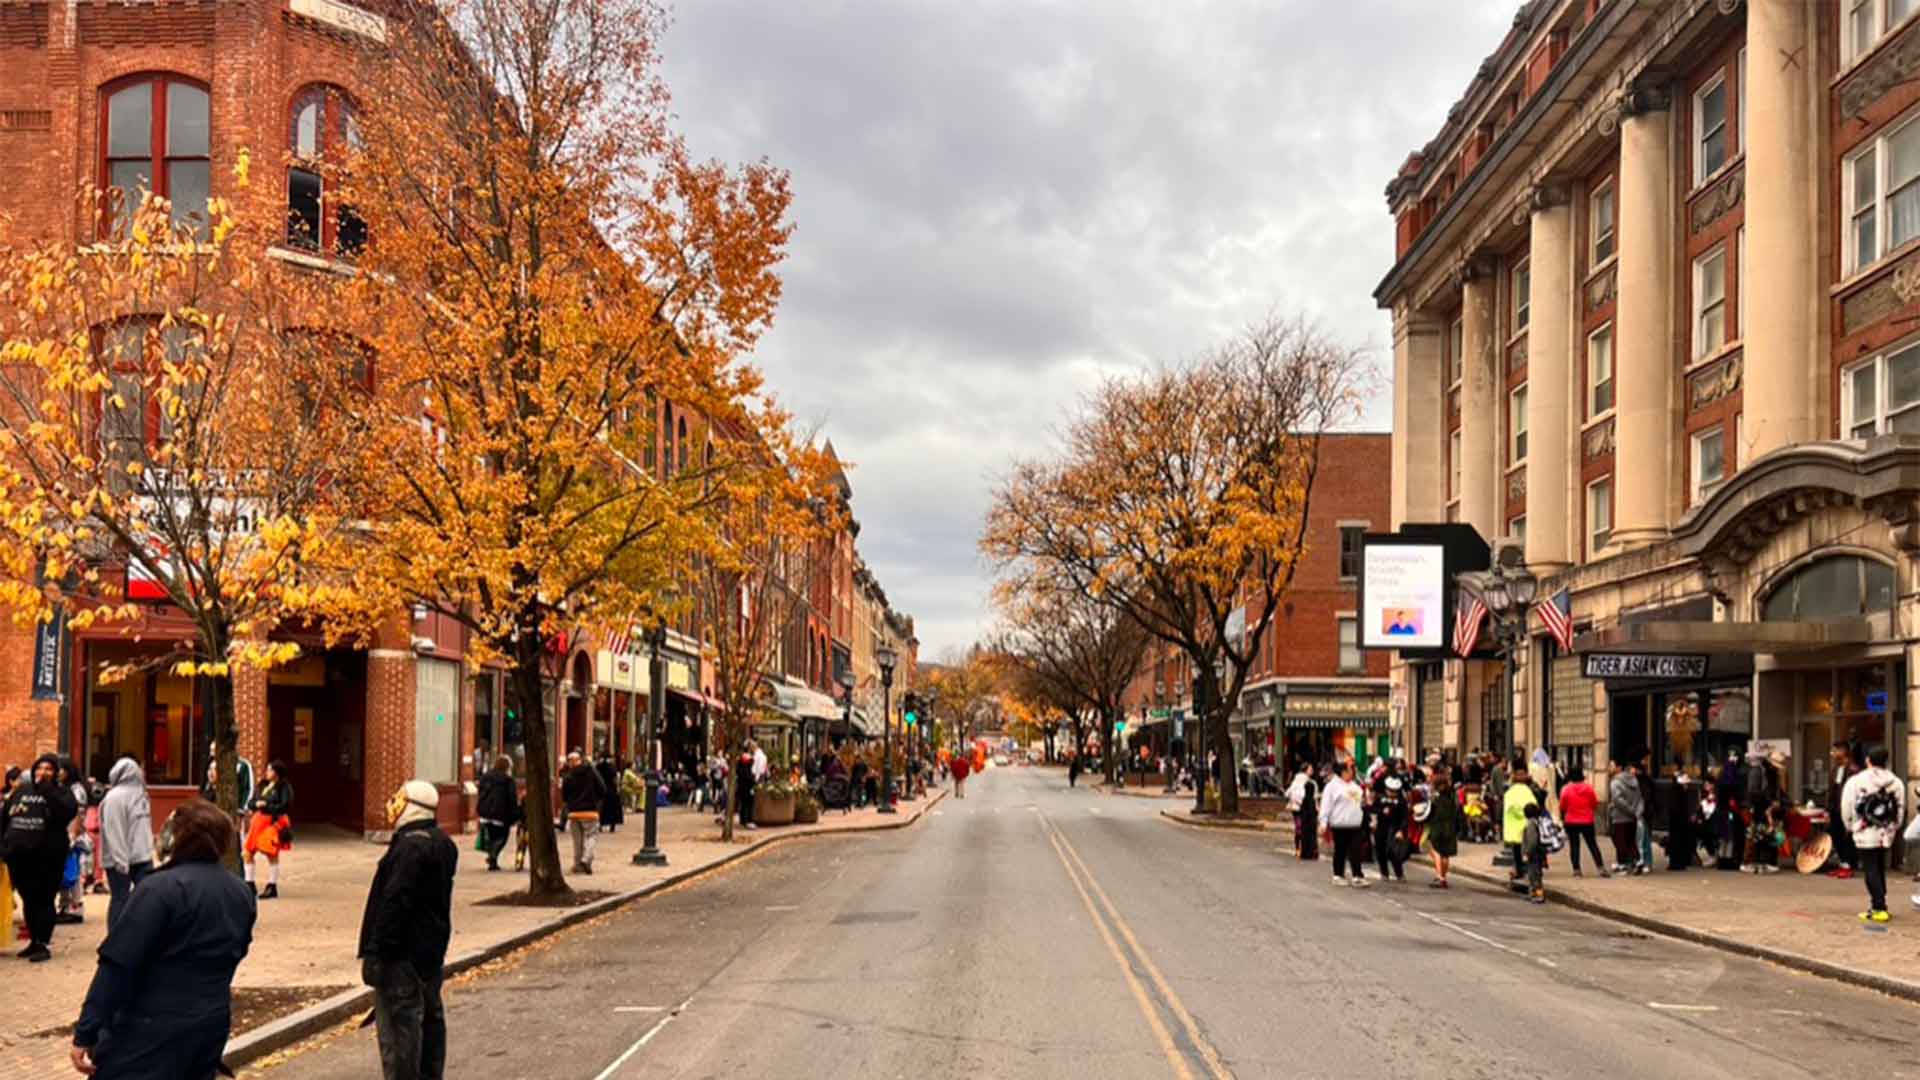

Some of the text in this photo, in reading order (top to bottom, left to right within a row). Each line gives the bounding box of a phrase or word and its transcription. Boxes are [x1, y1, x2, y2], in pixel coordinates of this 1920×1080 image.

[1588, 656, 1705, 676] TIGER ASIAN CUISINE
